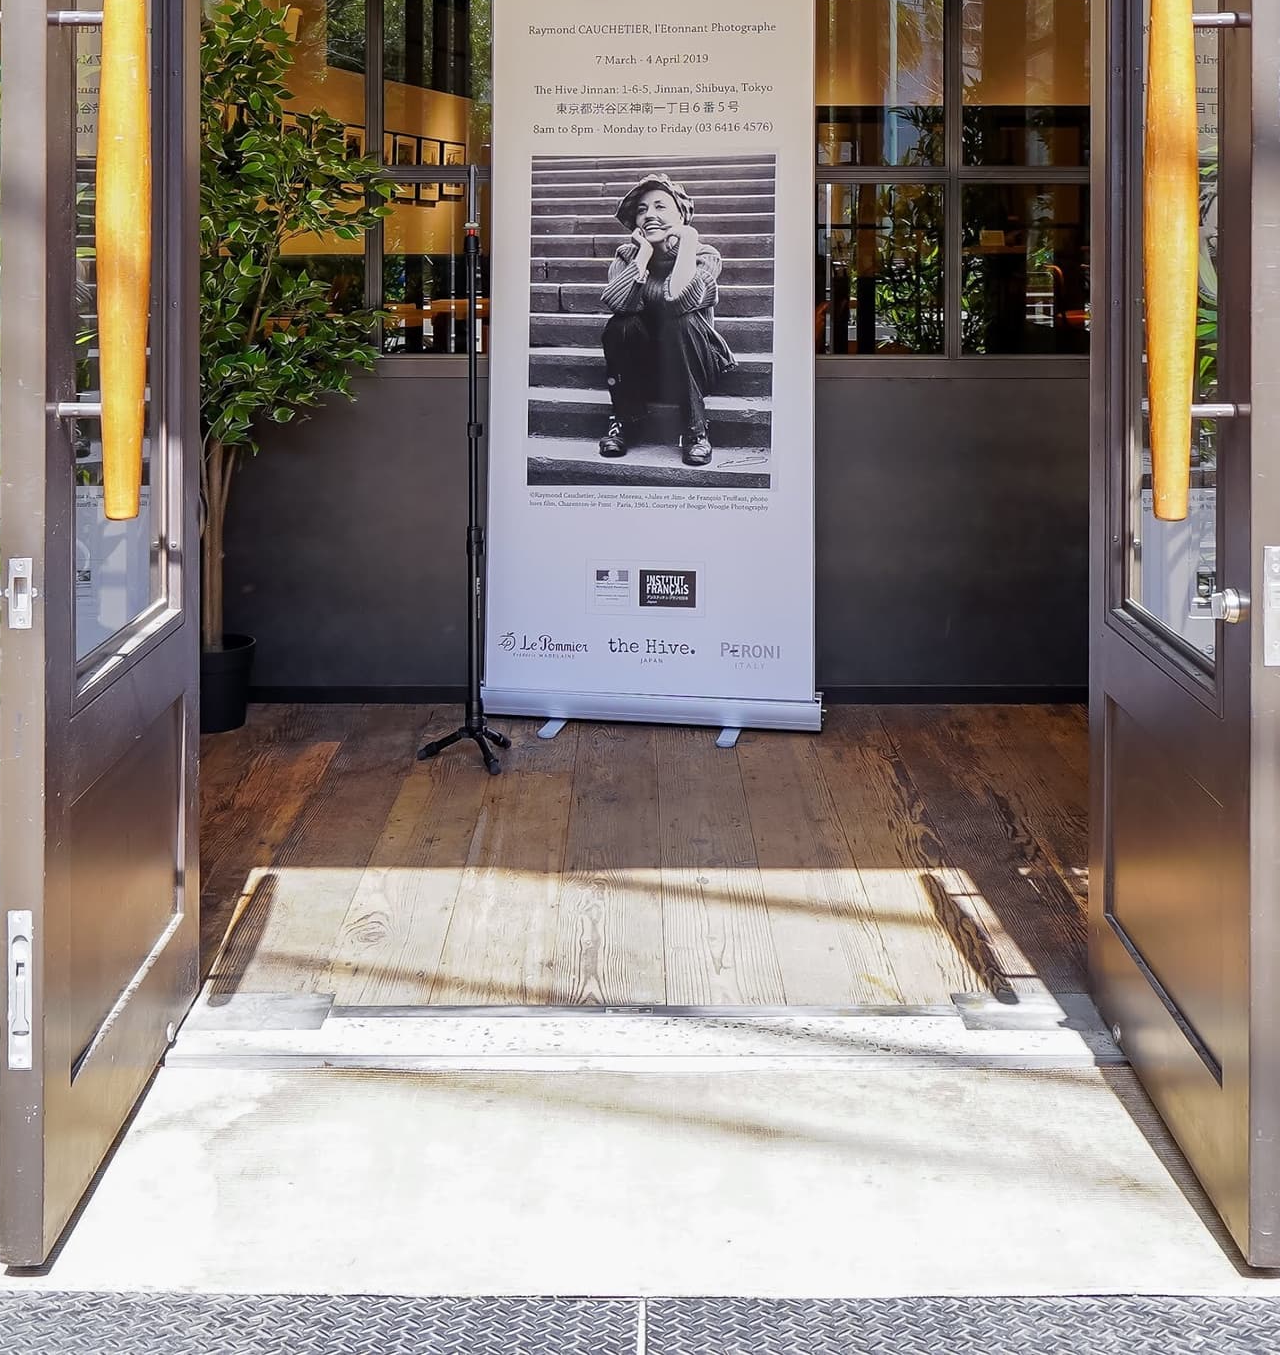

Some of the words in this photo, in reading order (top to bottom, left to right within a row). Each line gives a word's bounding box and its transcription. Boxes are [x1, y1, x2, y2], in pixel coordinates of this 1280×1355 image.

[528, 25, 576, 37] Raymond
[578, 24, 652, 35] CAUCHETIER,
[711, 21, 777, 34] Photographe
[595, 55, 602, 64] 7
[605, 54, 637, 65] March
[646, 55, 652, 64] 4
[655, 54, 680, 66] April
[683, 53, 709, 64] 2019
[534, 85, 552, 95] The
[555, 85, 578, 95] Hive
[580, 85, 619, 95] Jinnan:
[654, 84, 693, 94] Jinnan,
[695, 82, 738, 94] Shibuya,
[741, 82, 774, 94] Tokyo
[533, 124, 555, 134] 8am
[558, 125, 569, 134] to
[571, 124, 594, 136] 8pm
[603, 123, 645, 136] Monday
[647, 125, 658, 133] to
[660, 122, 693, 135] Friday
[695, 122, 712, 133] (03
[714, 122, 740, 132] 6416
[743, 121, 774, 133] 4576)
[750, 495, 769, 504] photo
[616, 501, 634, 510] Paris,
[651, 501, 678, 511] Courtesy
[686, 502, 706, 512] Boogie
[707, 503, 730, 512] Woogie
[730, 503, 769, 512] Photography
[646, 574, 685, 586] INSTITUT
[520, 634, 538, 651] Le
[538, 634, 589, 652] Pommier
[608, 637, 640, 653] the
[645, 638, 696, 655] Hive.
[719, 641, 781, 659] PERONI
[734, 662, 766, 670] ITALY
